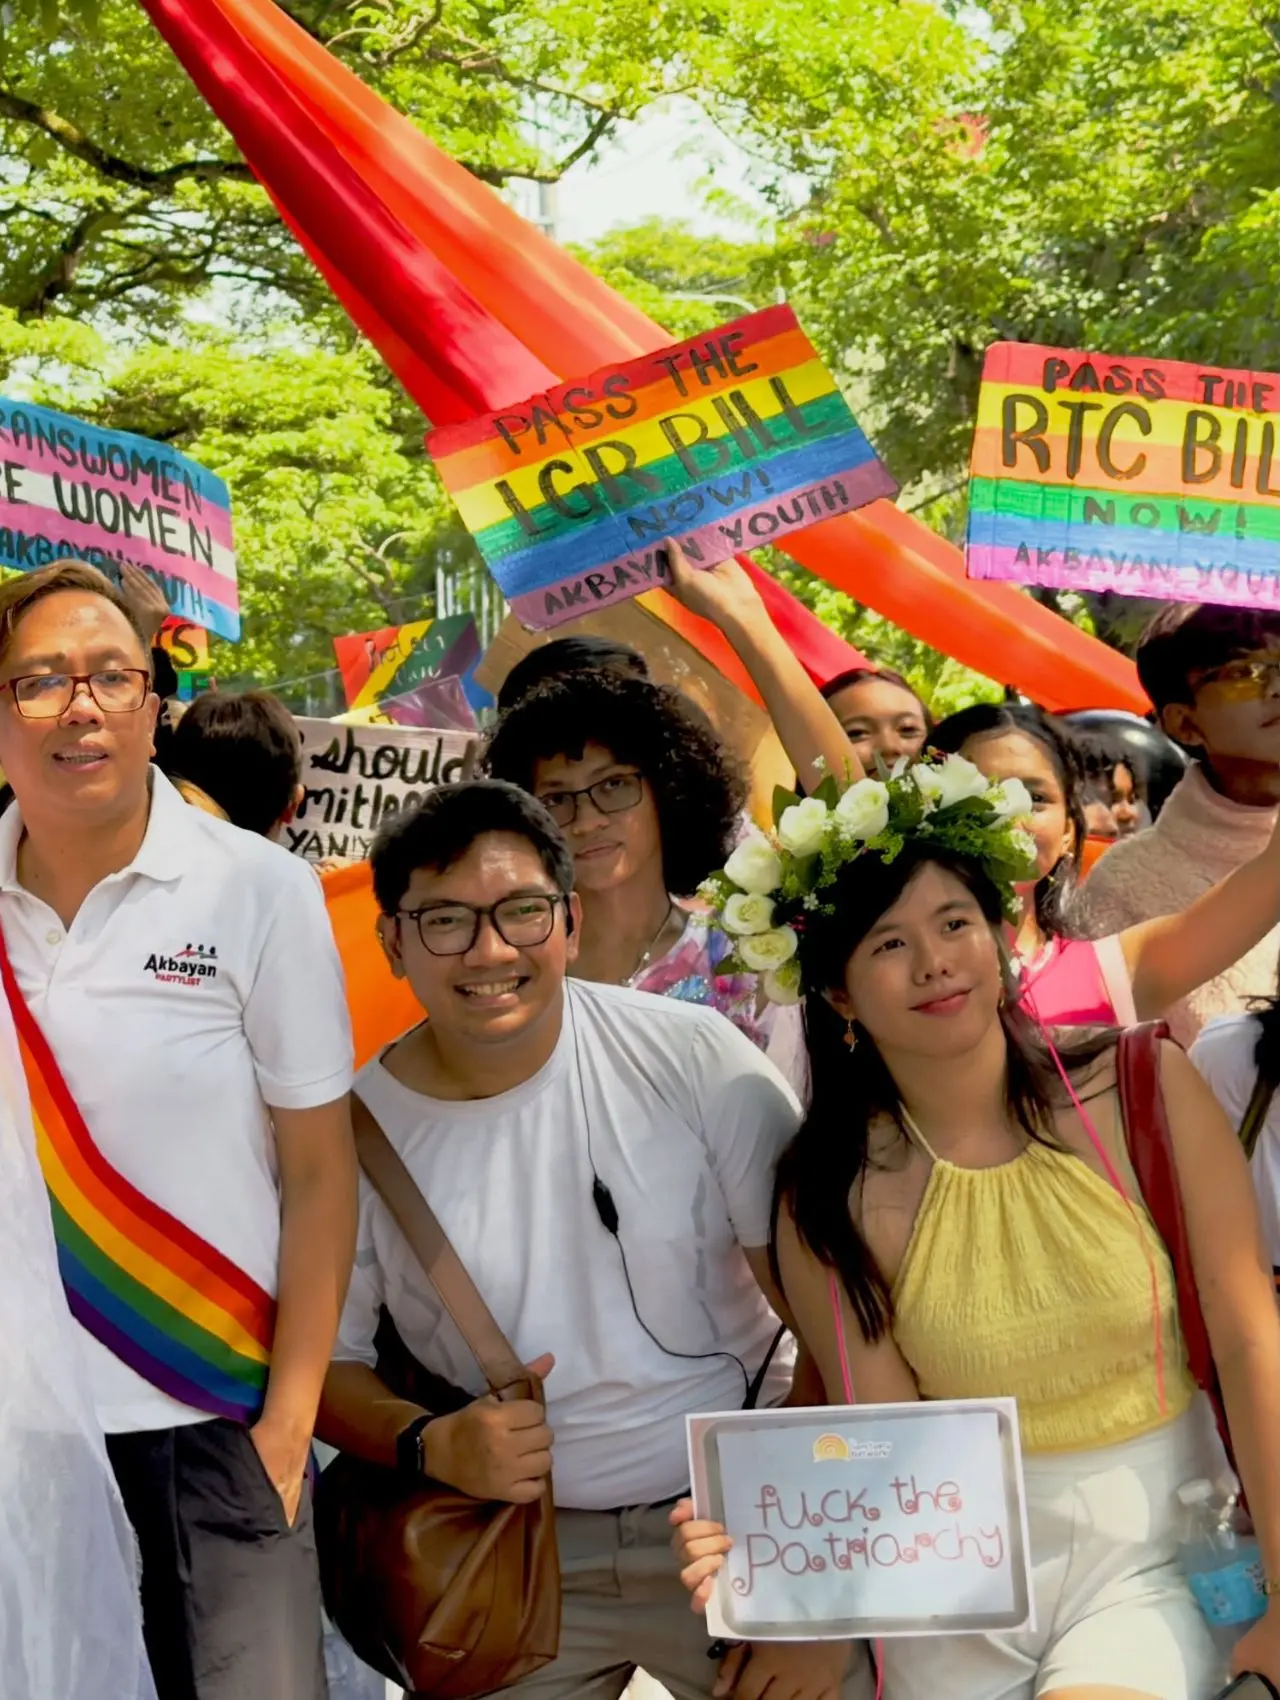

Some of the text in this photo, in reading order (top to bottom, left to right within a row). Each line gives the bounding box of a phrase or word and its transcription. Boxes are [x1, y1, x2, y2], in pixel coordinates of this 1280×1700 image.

[491, 331, 758, 455] PASS THE
[1043, 357, 1275, 412] PASS THE
[493, 376, 827, 538] LGR BILL
[1002, 394, 1152, 480] RTC
[53, 471, 213, 569] WOMEN
[627, 466, 773, 540] NOW!
[719, 479, 850, 547] YOUTH
[1014, 541, 1171, 580] AKBAYAN
[143, 953, 217, 977] Akbayan
[889, 1475, 963, 1515] the
